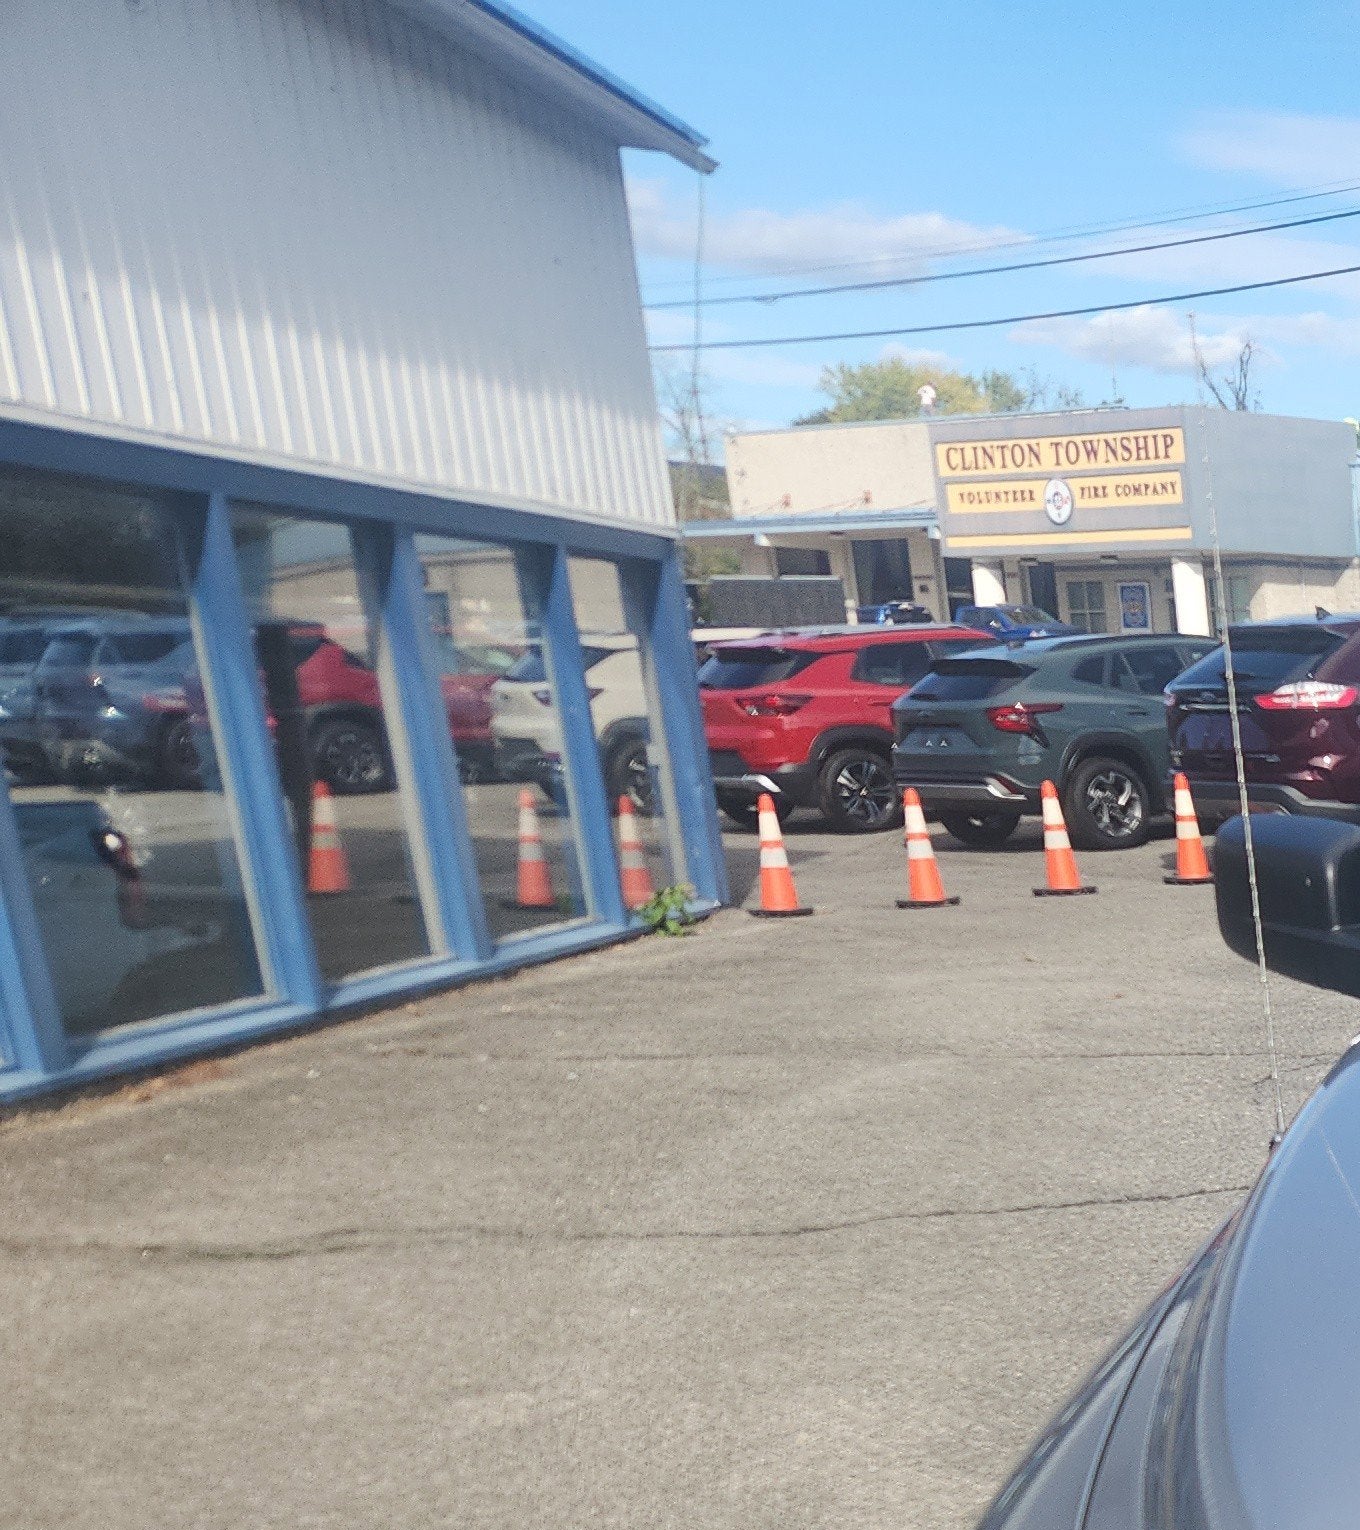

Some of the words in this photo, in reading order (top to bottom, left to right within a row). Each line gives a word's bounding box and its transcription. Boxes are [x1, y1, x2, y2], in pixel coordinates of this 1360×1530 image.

[946, 442, 1043, 471] CLINTON
[1050, 433, 1175, 467] TOWNSHIP
[959, 488, 1036, 504] VOLUNTEER
[1080, 485, 1109, 499] FIRE
[1115, 480, 1178, 498] COMPANY
